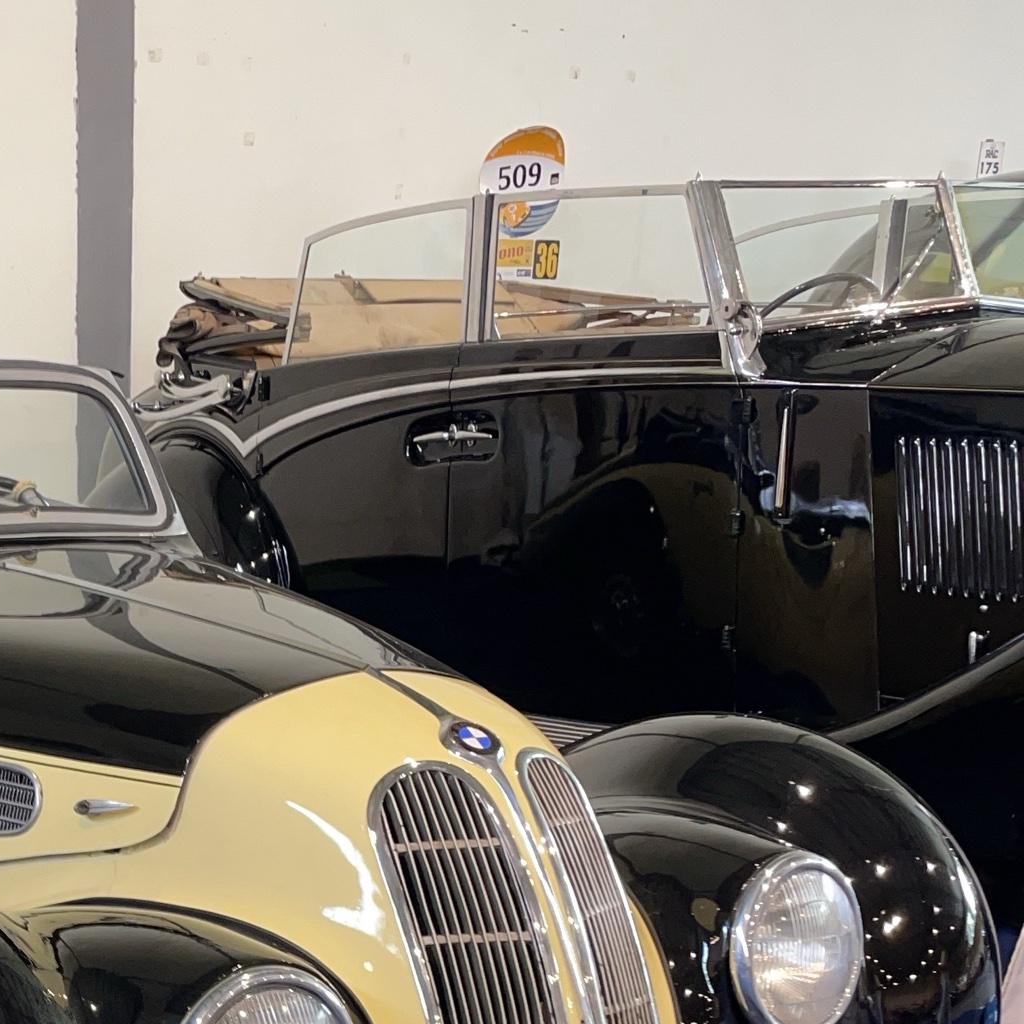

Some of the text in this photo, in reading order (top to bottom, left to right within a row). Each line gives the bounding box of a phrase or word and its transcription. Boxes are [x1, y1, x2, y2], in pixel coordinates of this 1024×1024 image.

[498, 162, 542, 191] 509
[980, 161, 999, 175] 175
[535, 242, 558, 279] 36
